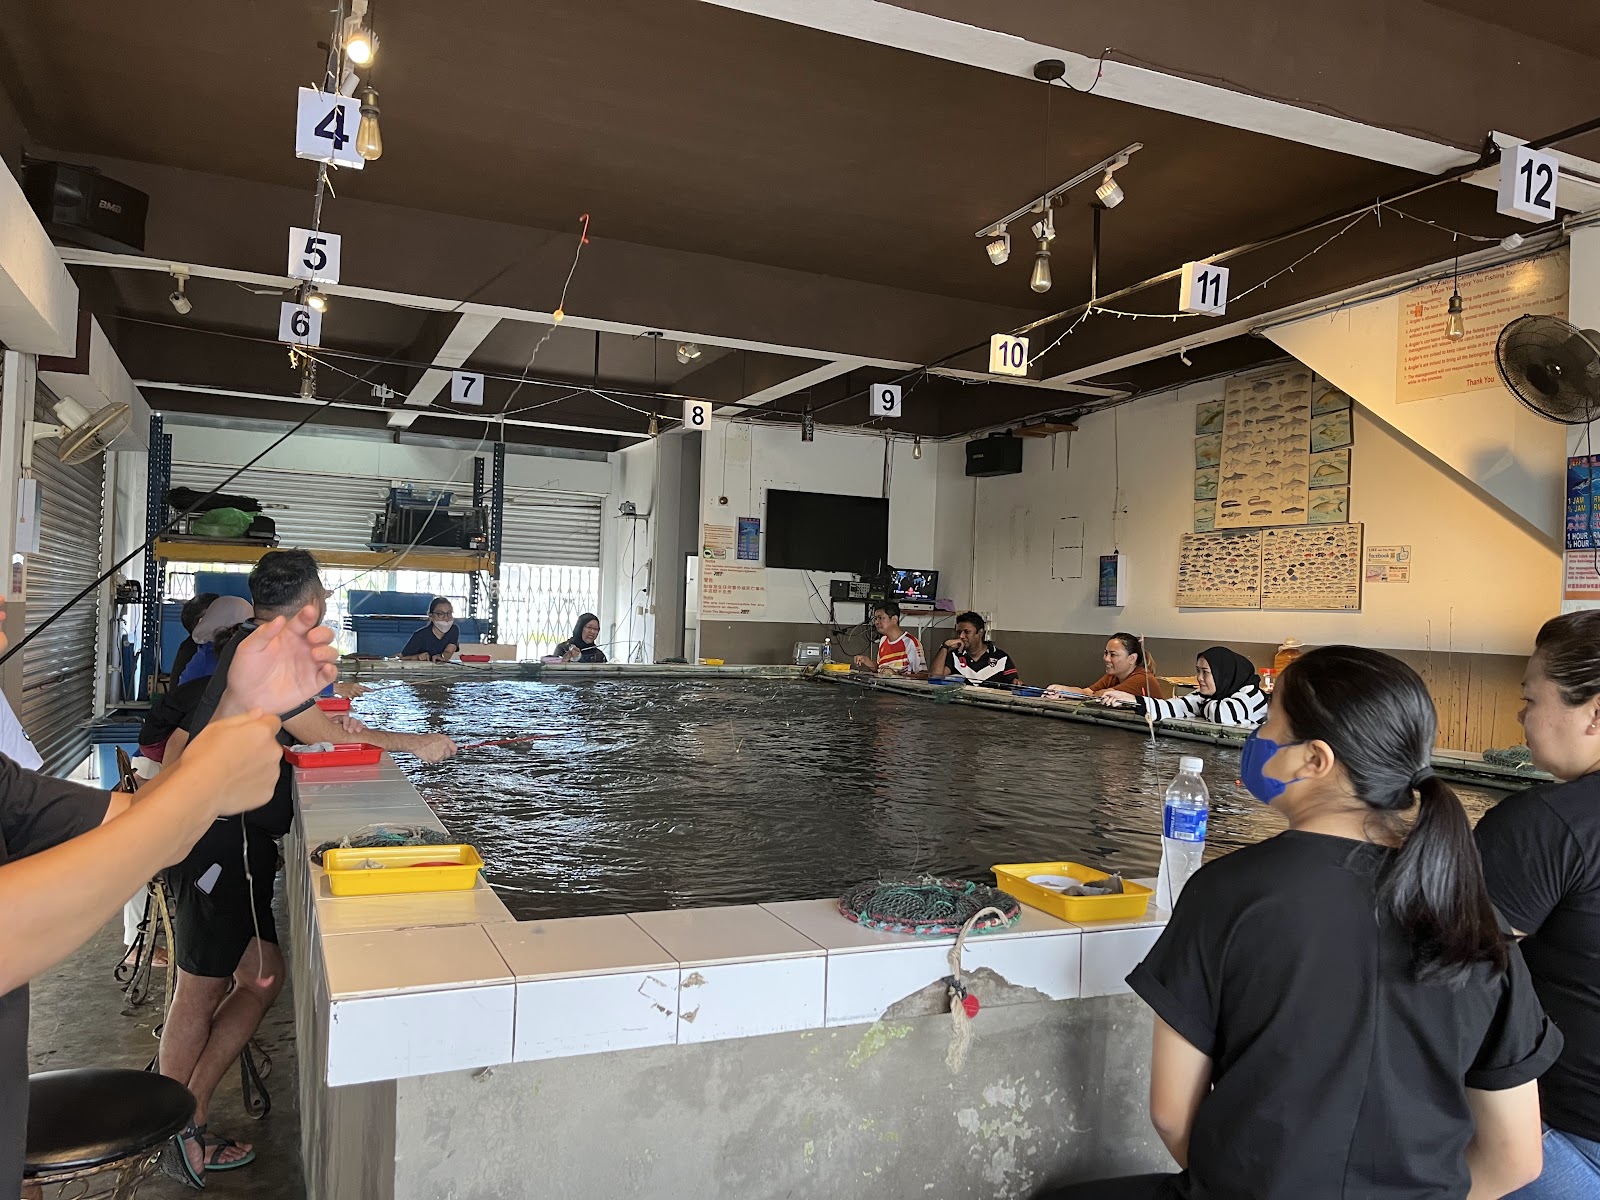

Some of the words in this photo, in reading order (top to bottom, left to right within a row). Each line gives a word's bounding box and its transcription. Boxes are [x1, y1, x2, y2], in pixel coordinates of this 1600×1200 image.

[314, 105, 350, 150] 4
[1521, 159, 1553, 210] 12
[303, 236, 327, 271] 5
[1198, 271, 1221, 306] 11
[1457, 281, 1471, 289] Enjoy
[1484, 272, 1505, 281] Fishing
[291, 311, 311, 336] 6
[1000, 342, 1024, 368] 10
[462, 376, 476, 397] 7
[1466, 379, 1483, 388] Thank
[1484, 376, 1495, 384] You
[882, 390, 895, 412] 9
[691, 406, 704, 424] 8
[1572, 497, 1585, 505] JAM
[1574, 504, 1586, 512] JAM
[1572, 532, 1588, 540] HOUR
[1574, 539, 1590, 548] HOUR
